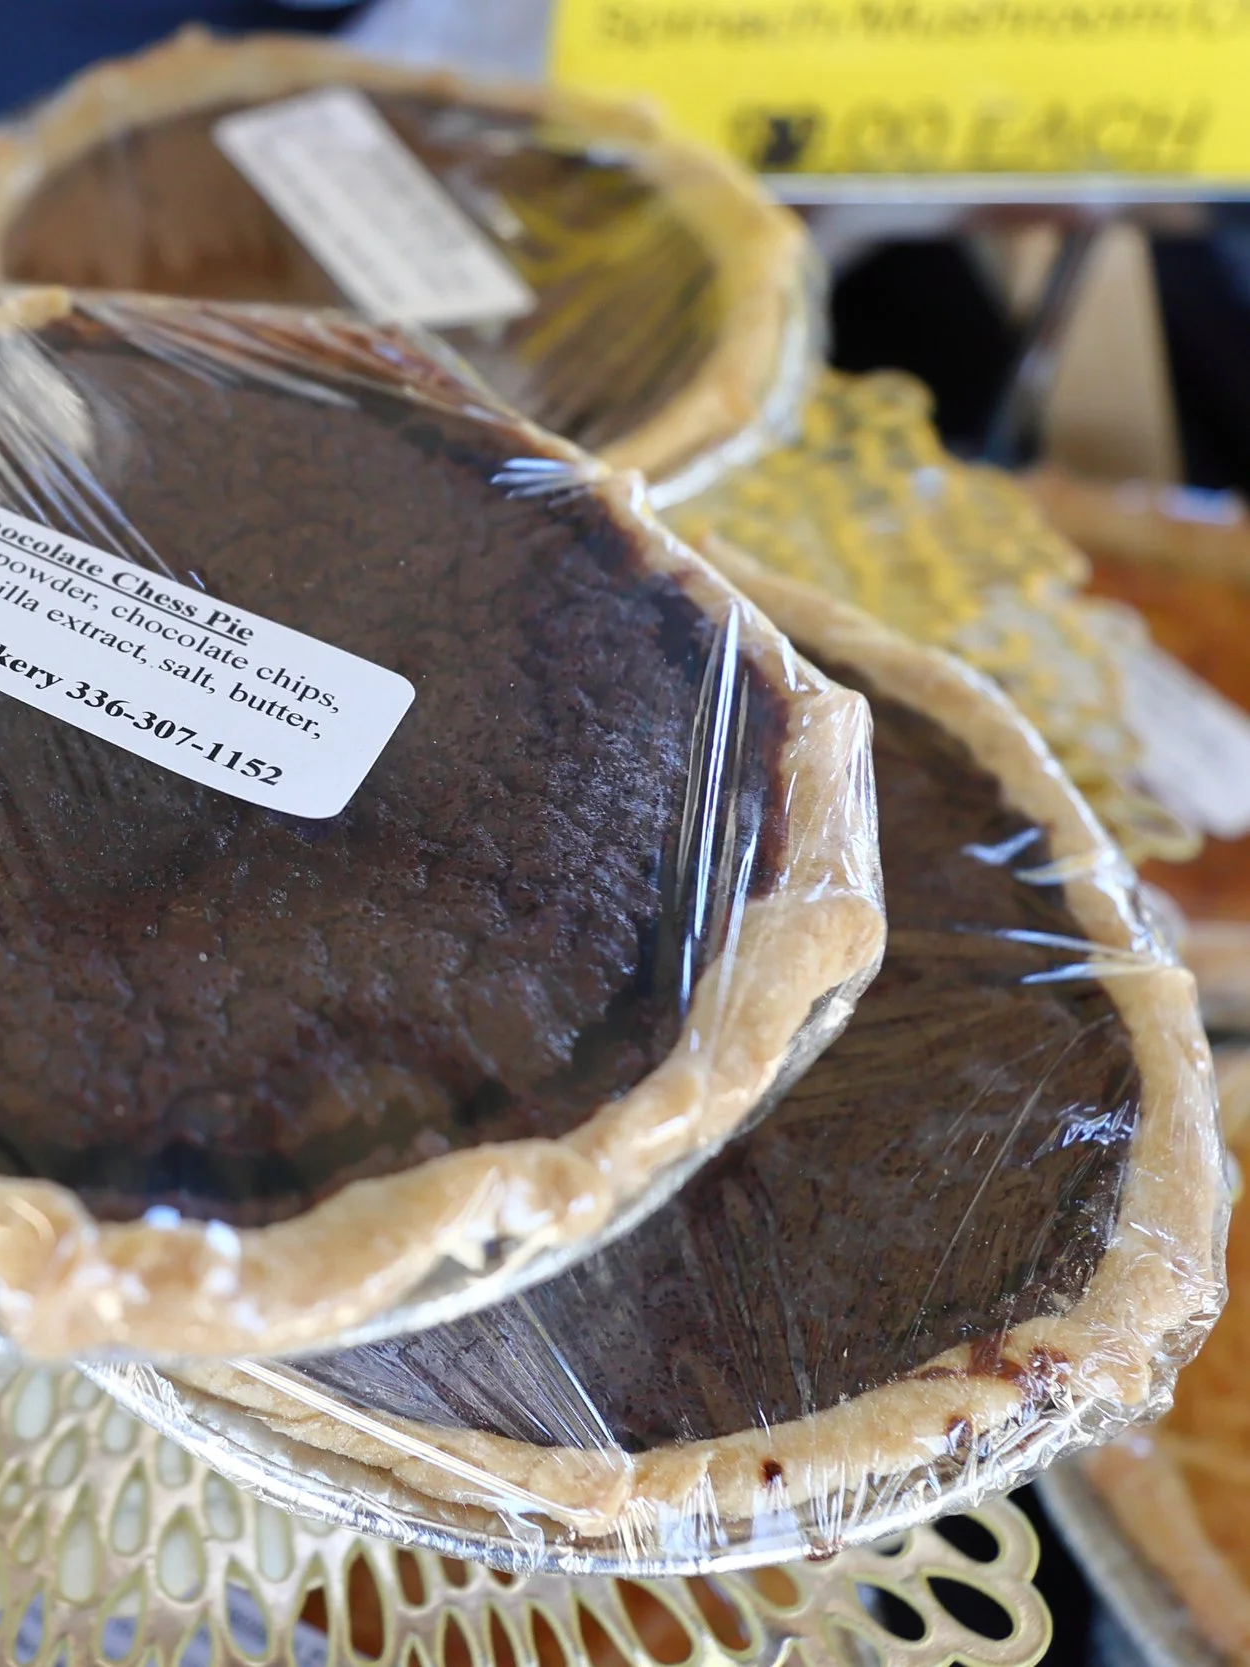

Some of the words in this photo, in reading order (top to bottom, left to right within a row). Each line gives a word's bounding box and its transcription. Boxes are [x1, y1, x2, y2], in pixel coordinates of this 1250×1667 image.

[110, 604, 248, 669] chocolate
[256, 660, 340, 712] chips,
[112, 571, 201, 619] Chess
[208, 608, 254, 641] Pie
[45, 607, 147, 666] extract,
[159, 658, 215, 694] salt,
[227, 681, 321, 739] butter,
[66, 681, 284, 785] 336-307-1152
